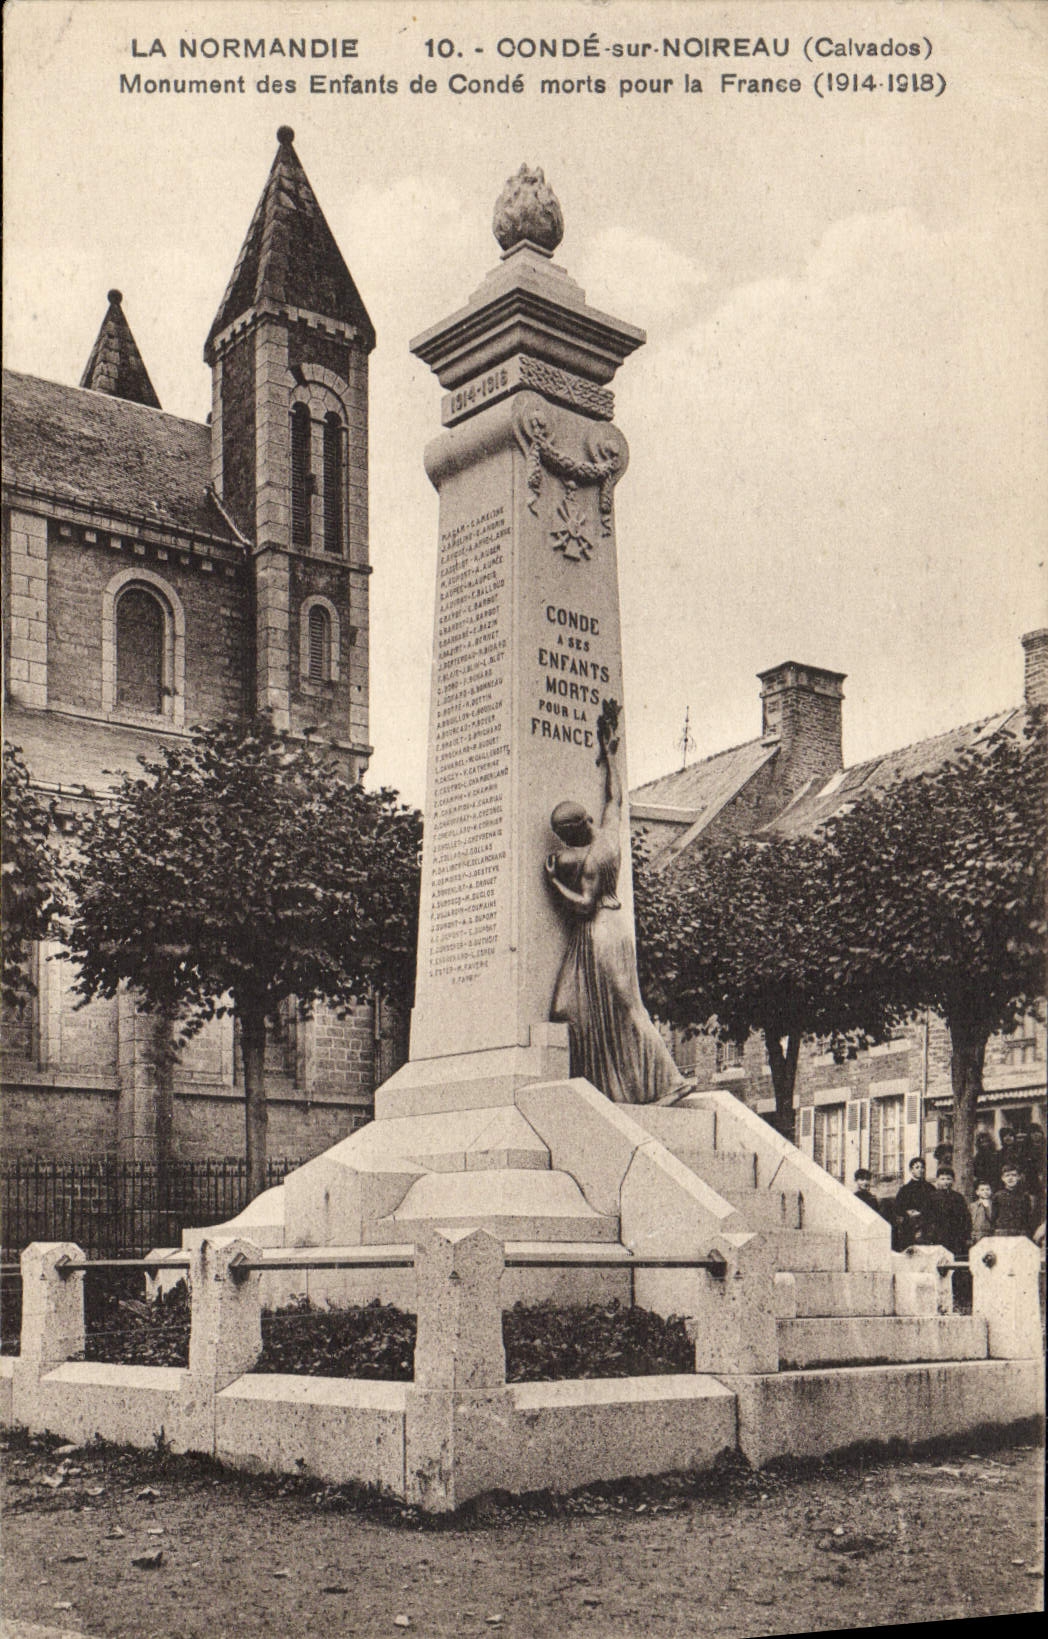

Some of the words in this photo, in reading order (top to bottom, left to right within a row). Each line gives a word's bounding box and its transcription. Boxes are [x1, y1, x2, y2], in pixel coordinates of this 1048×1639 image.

[546, 605, 600, 636] CONDE
[557, 634, 564, 646] A
[568, 637, 590, 653] SES
[538, 648, 610, 683] ENFANTS
[546, 675, 600, 706] MORTS
[539, 699, 569, 718] POUR
[573, 708, 587, 722] LA
[531, 717, 593, 748] FRANCE
